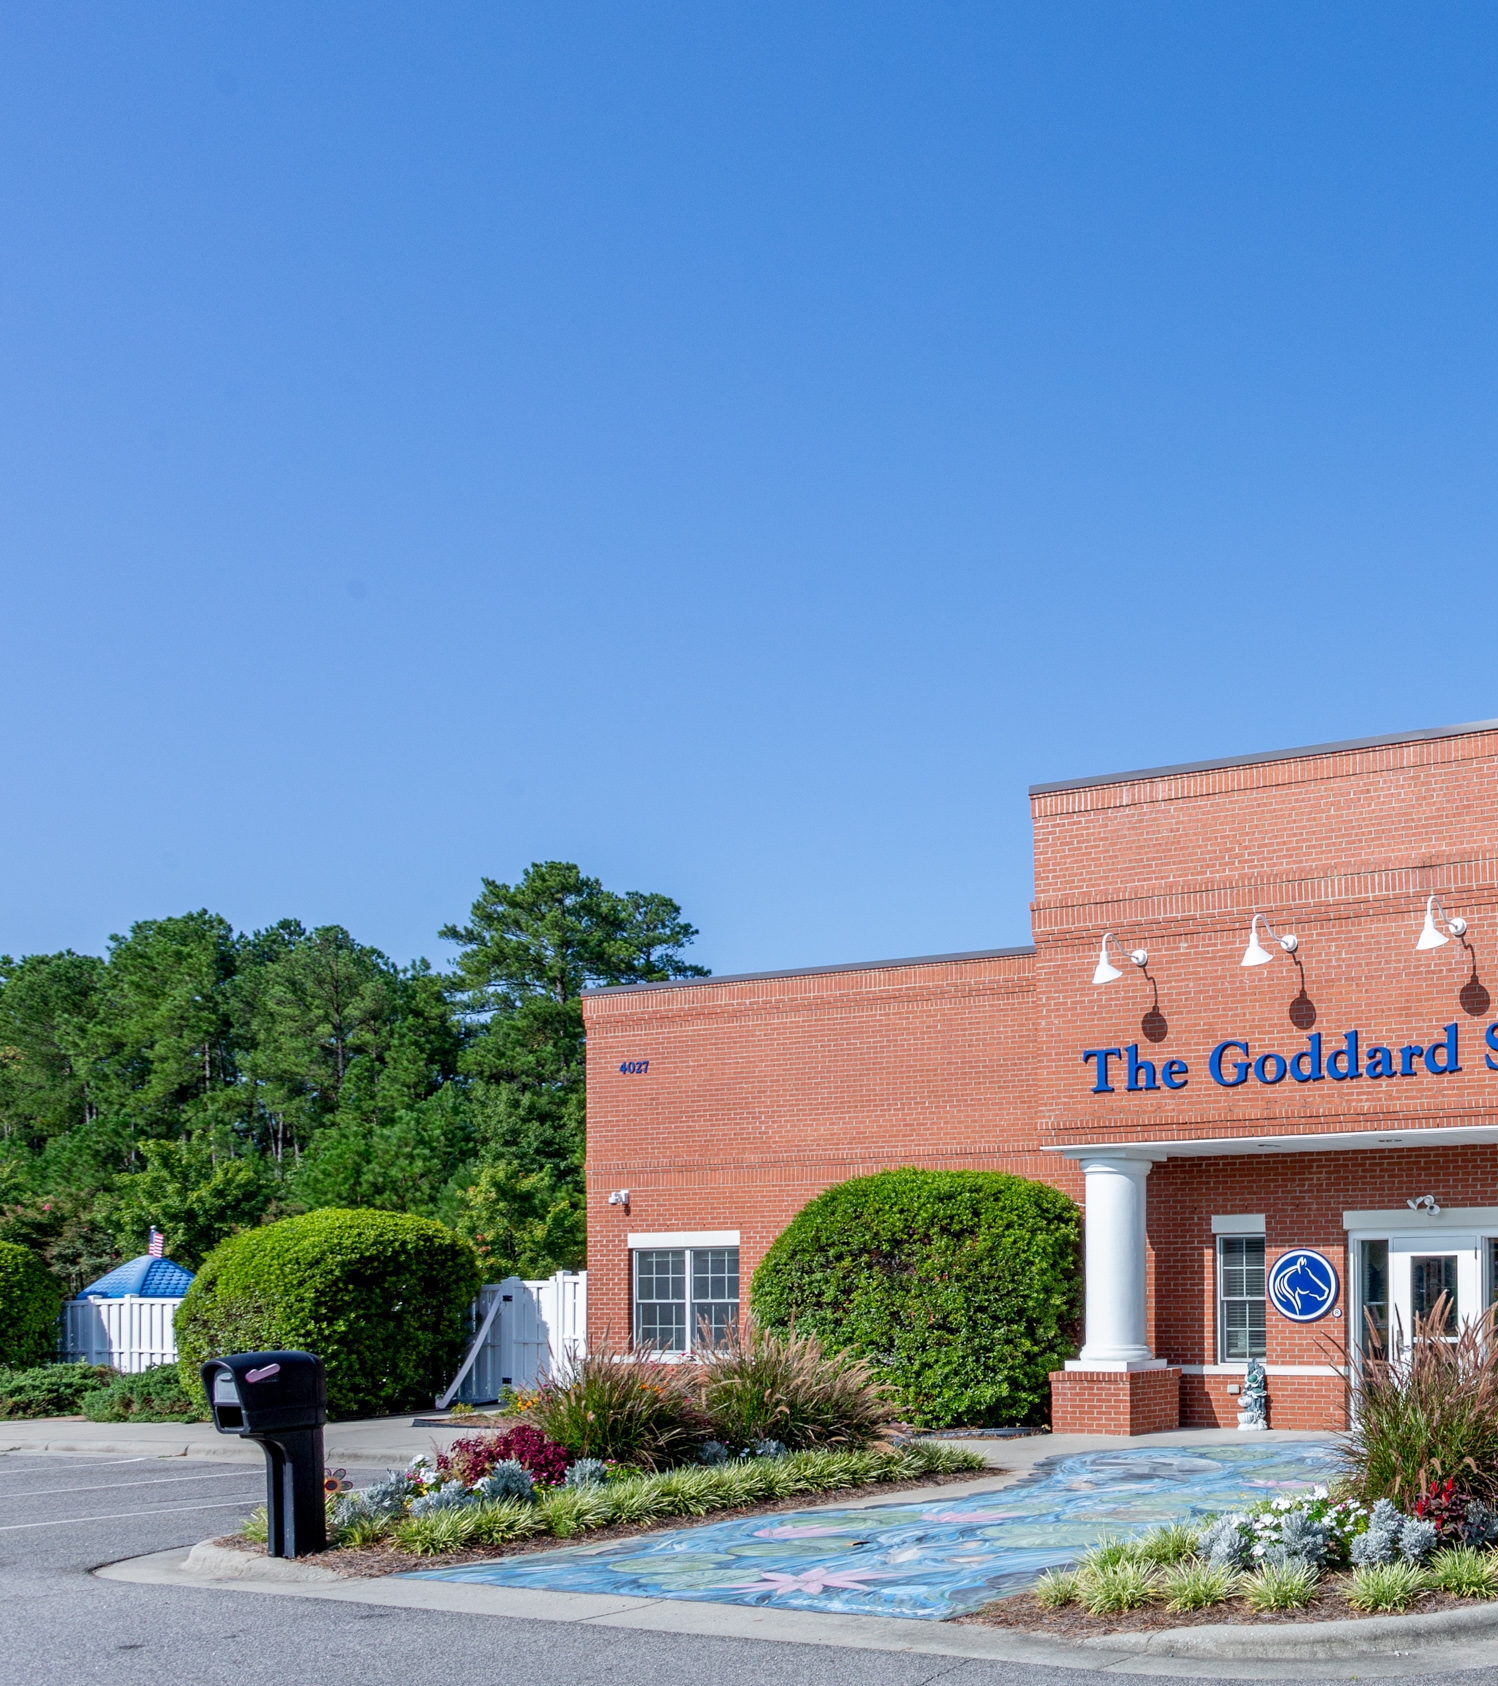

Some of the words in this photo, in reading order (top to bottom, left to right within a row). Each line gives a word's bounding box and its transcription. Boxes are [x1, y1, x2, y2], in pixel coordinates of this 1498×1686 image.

[619, 1060, 649, 1074] 4027
[1083, 1043, 1189, 1093] The
[1208, 1022, 1462, 1087] Goddard
